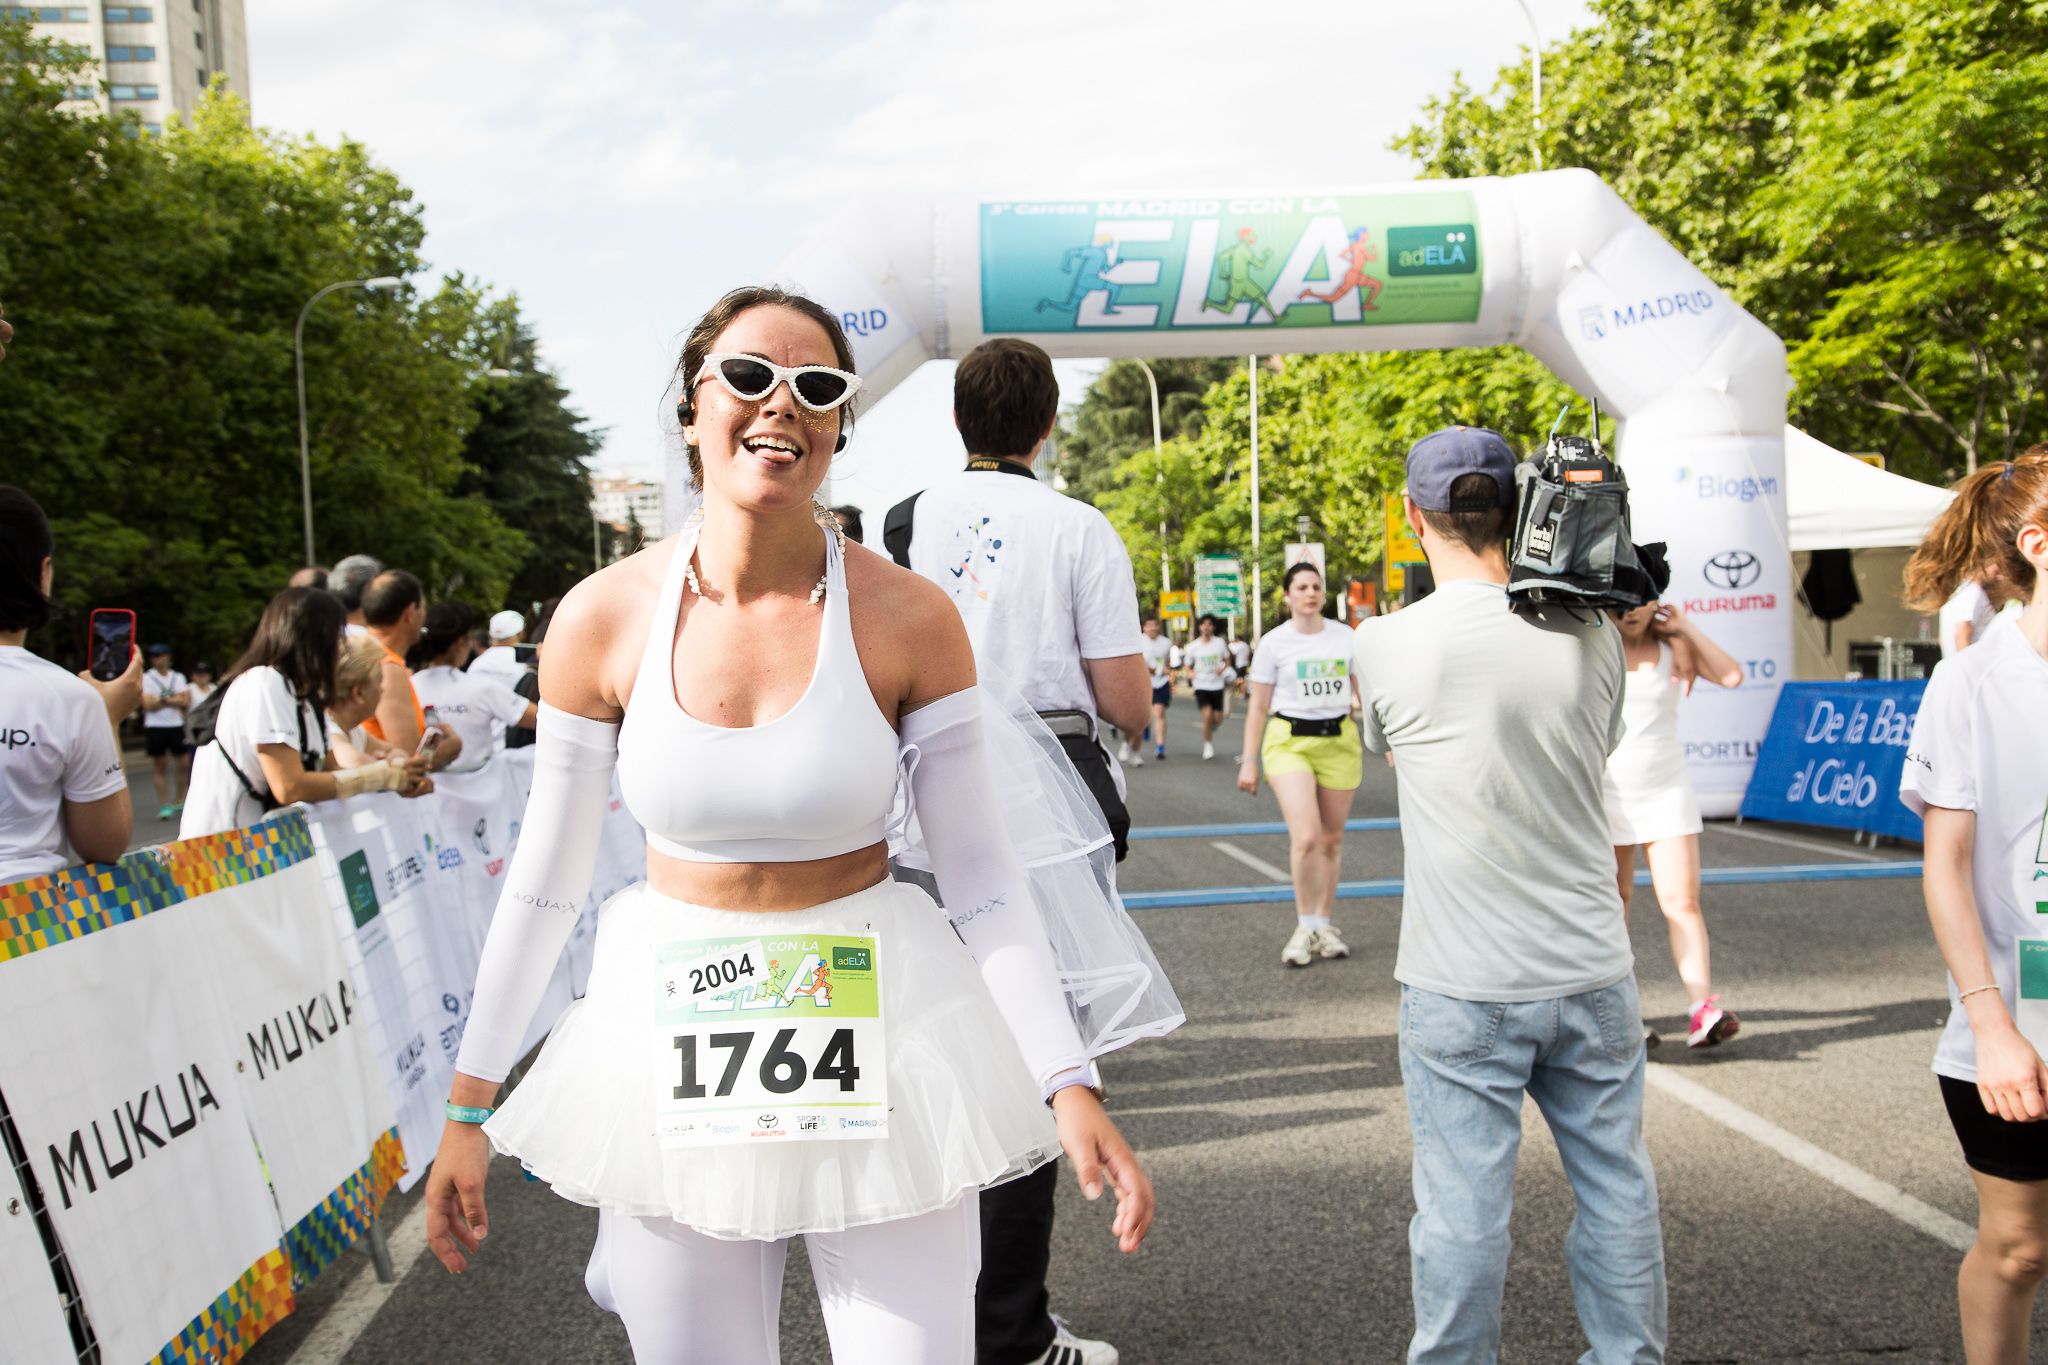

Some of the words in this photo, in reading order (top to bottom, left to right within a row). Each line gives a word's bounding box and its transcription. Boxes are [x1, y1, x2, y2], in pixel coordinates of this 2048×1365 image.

[1016, 202, 1088, 216] Carrera
[1095, 200, 1220, 217] MADRID
[1226, 198, 1294, 216] CON
[1301, 197, 1343, 214] LA
[1398, 244, 1466, 267] adELA
[1075, 215, 1364, 328] ELA
[1613, 289, 1713, 329] MADRID
[1699, 476, 1778, 502] Biogen
[1303, 680, 1343, 696] 1019
[1804, 700, 1845, 744] De
[1842, 700, 1869, 744] la
[1786, 759, 1816, 802] al
[1811, 758, 1877, 808] Cielo
[767, 941, 799, 952] CON
[801, 940, 819, 951] LA
[837, 956, 867, 966] adELA
[689, 953, 755, 995] 2004
[665, 979, 677, 997] 5K
[673, 1028, 861, 1100] 1764
[796, 1115, 820, 1123] SPORT
[800, 1122, 817, 1130] LIFE
[847, 1119, 878, 1128] MADRID
[48, 1064, 220, 1210] MUKUA
